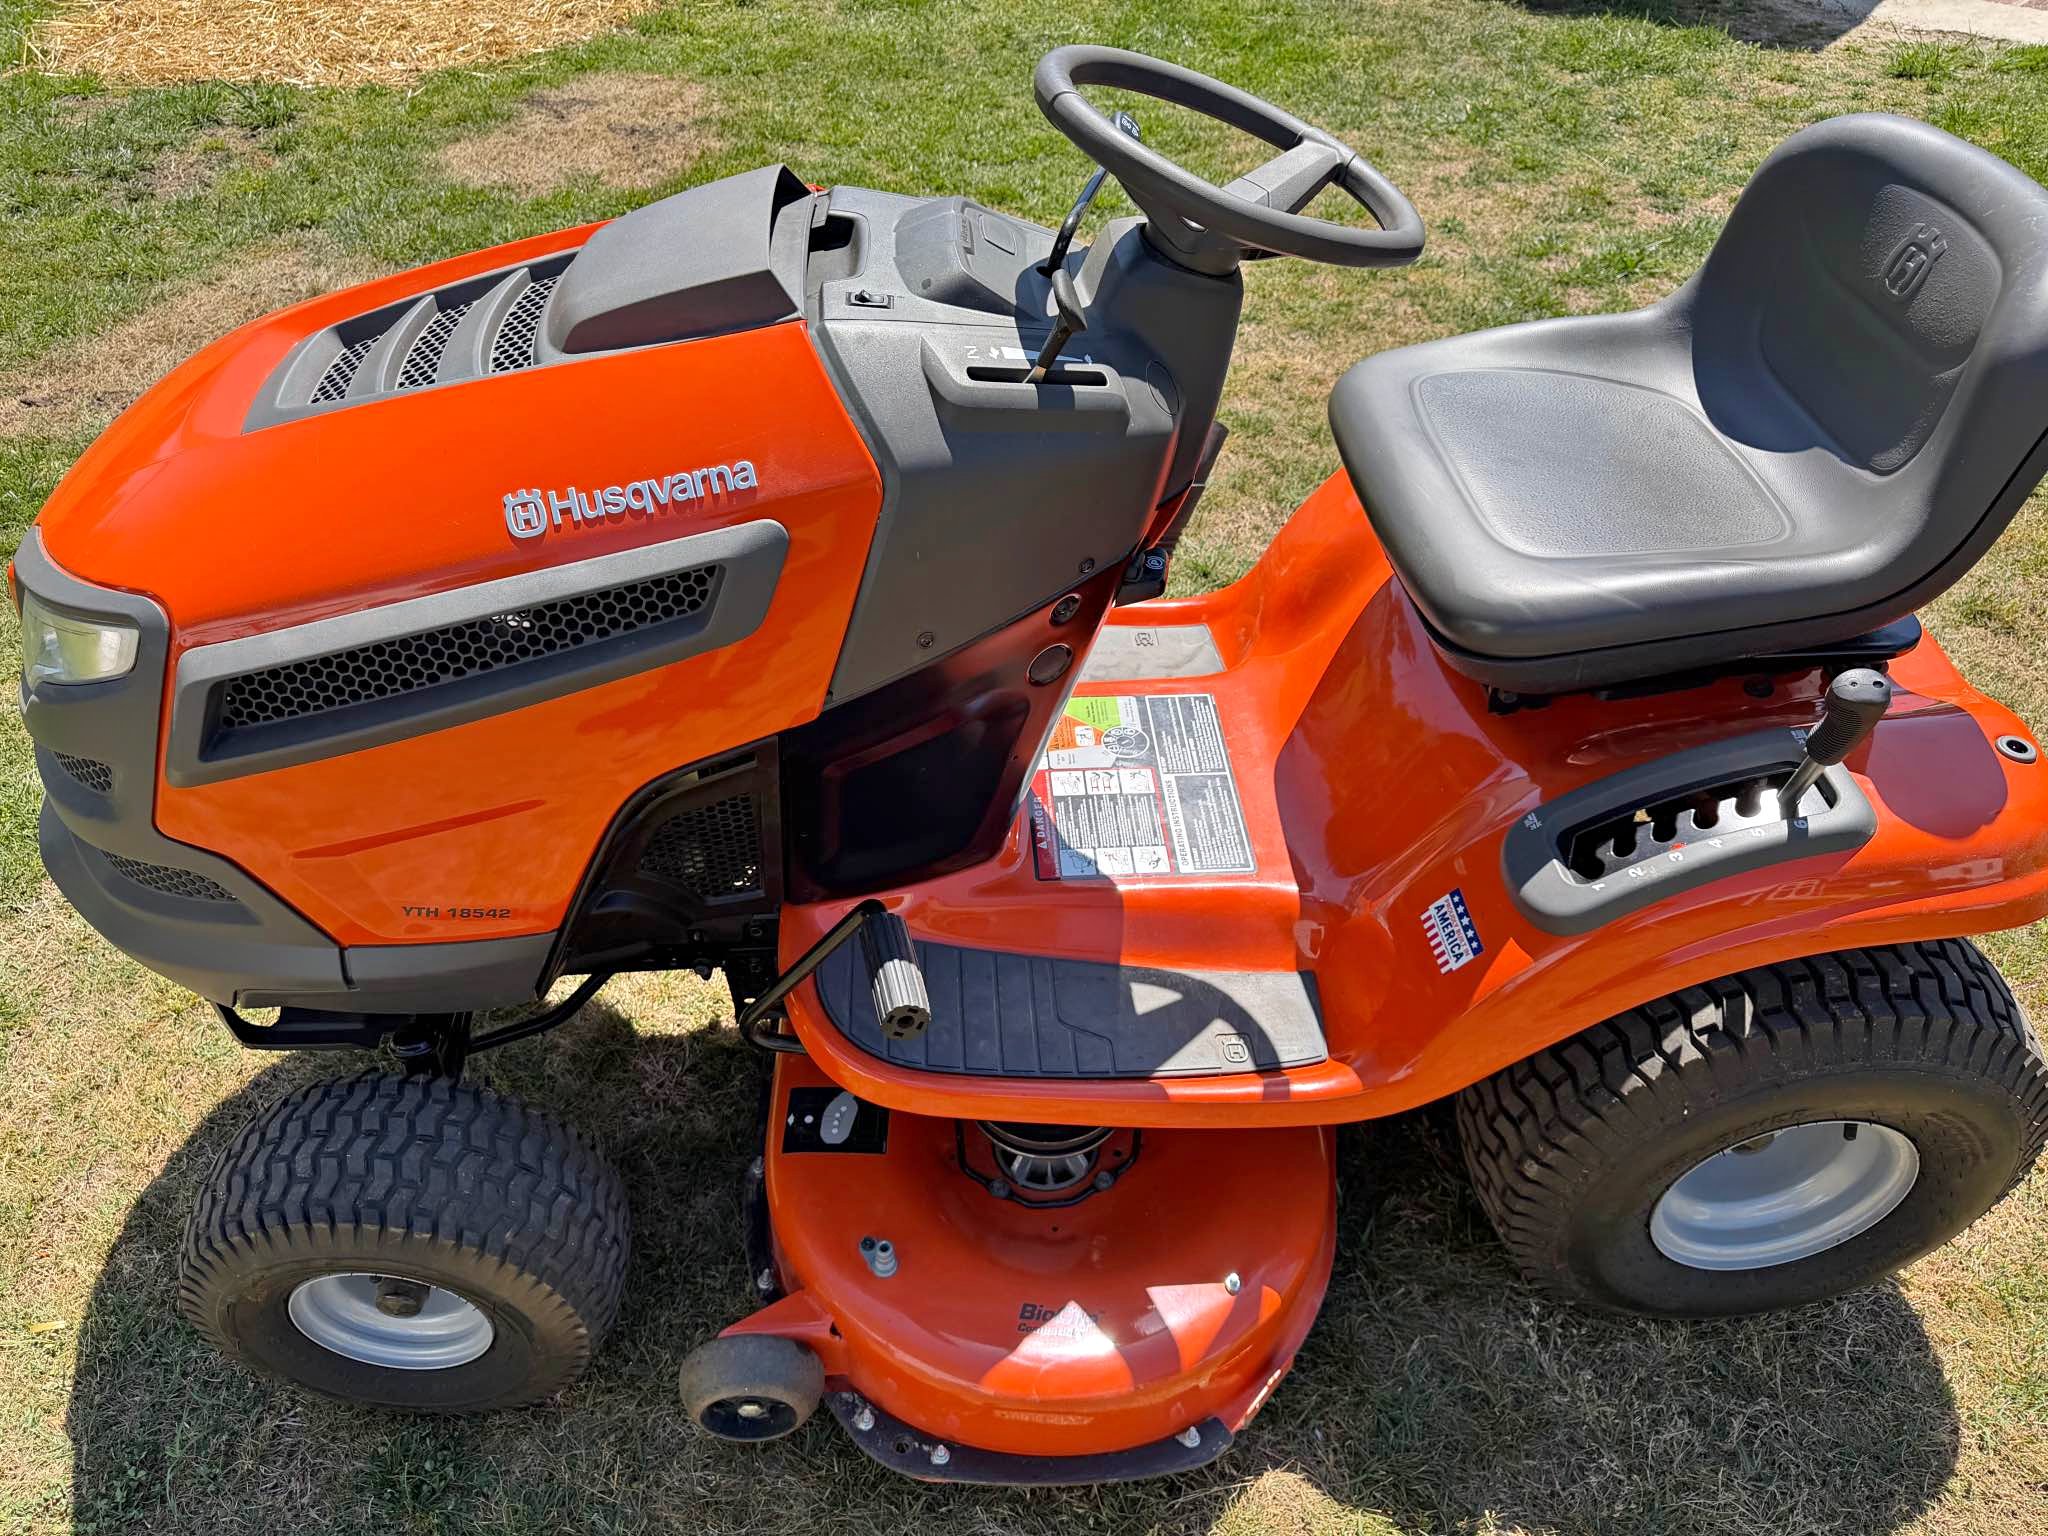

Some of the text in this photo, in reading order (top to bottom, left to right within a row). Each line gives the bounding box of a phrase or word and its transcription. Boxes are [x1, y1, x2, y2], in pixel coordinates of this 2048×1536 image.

[547, 460, 759, 526] Husqvarna
[1165, 780, 1181, 827] INSTRUCTIONS
[1034, 796, 1047, 838] DANGER
[1794, 819, 1808, 829] 6
[1752, 827, 1765, 838] 5
[1175, 828, 1190, 866] OPERATING
[1669, 851, 1684, 862] 3
[1628, 867, 1647, 880] 2
[1591, 882, 1606, 892] 1
[402, 906, 512, 919] YTH 18542
[1433, 903, 1465, 964] AMERICA
